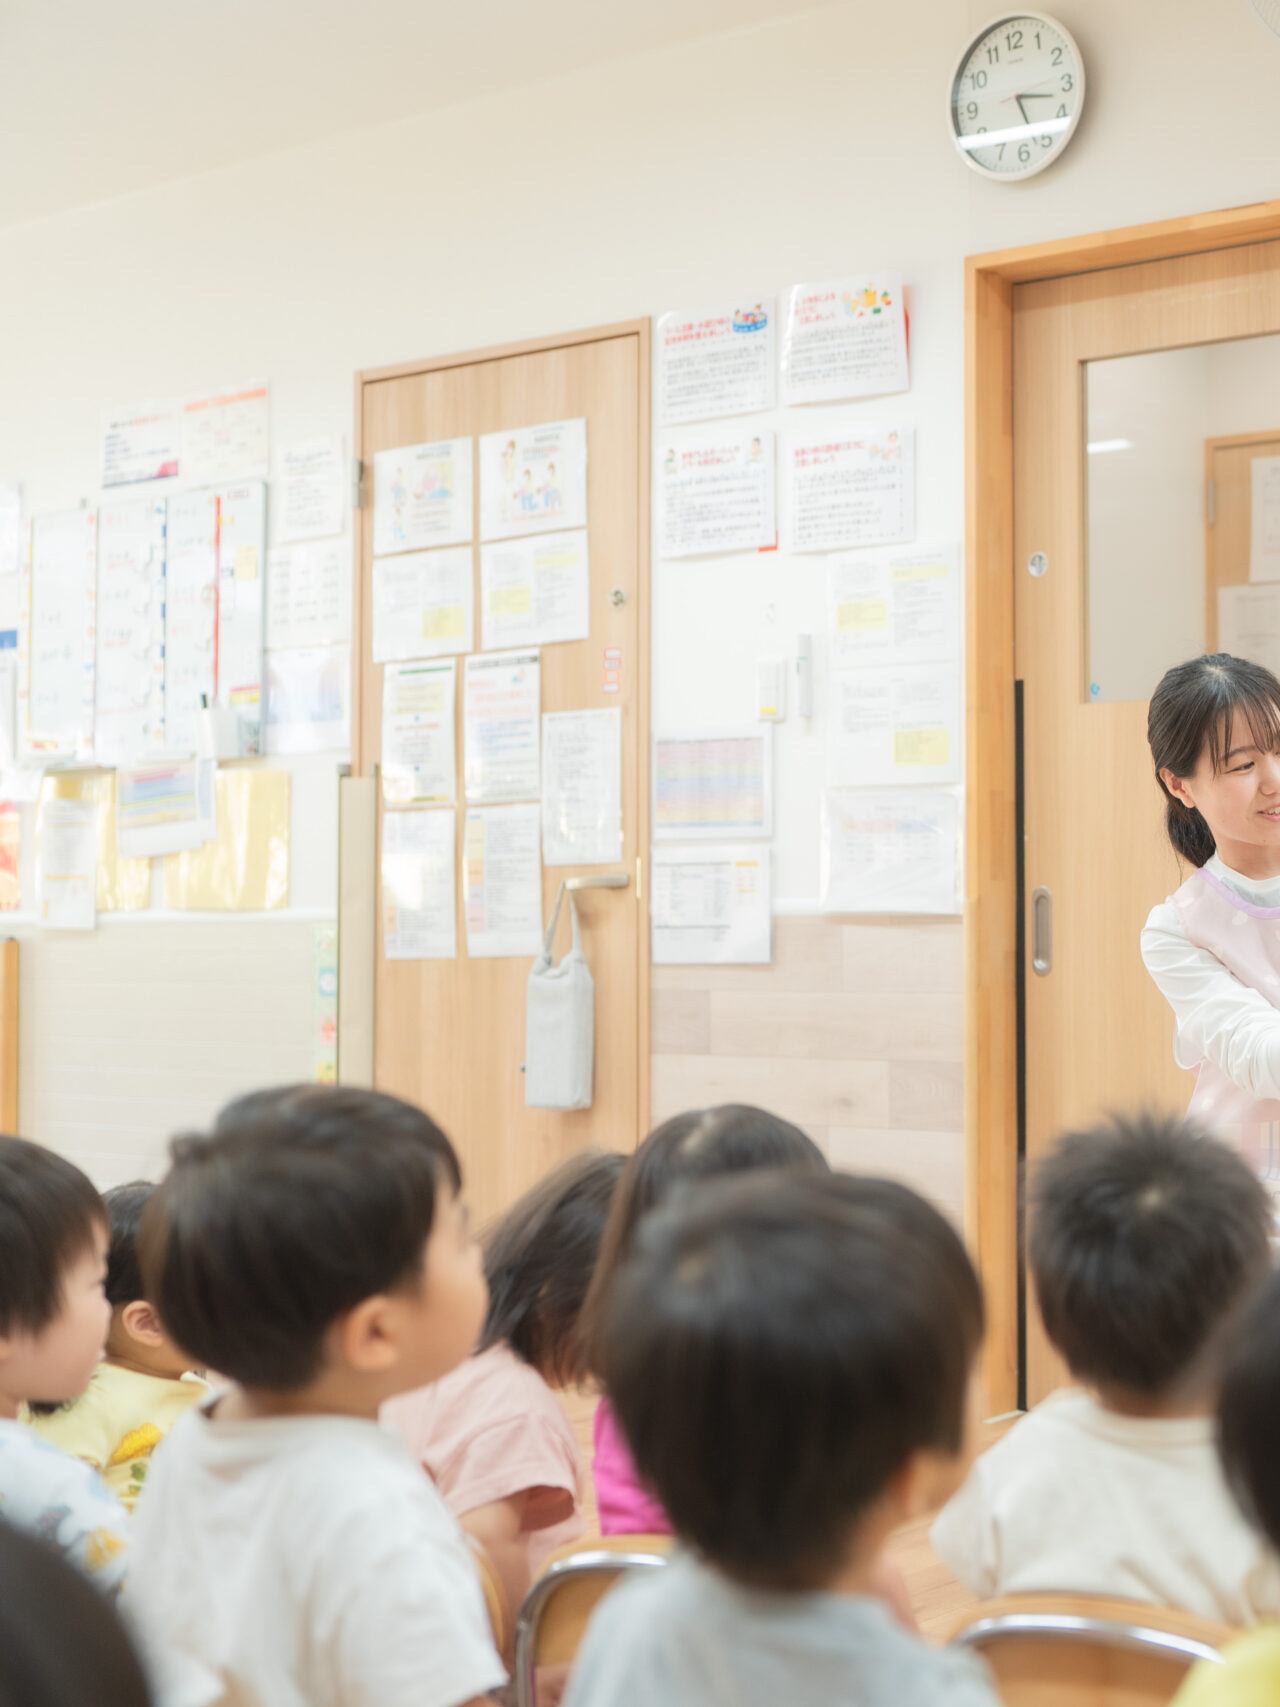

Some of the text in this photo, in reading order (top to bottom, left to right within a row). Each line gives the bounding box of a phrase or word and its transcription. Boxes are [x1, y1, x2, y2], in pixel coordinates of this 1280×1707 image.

[1005, 31, 1024, 51] 12
[1034, 32, 1041, 50] 1
[986, 45, 999, 64] 11
[1051, 47, 1063, 66] 2
[970, 70, 987, 90] 10
[1061, 73, 1073, 92] 3
[966, 102, 978, 120] 9
[995, 143, 1006, 160] 7
[1017, 144, 1030, 162] 6
